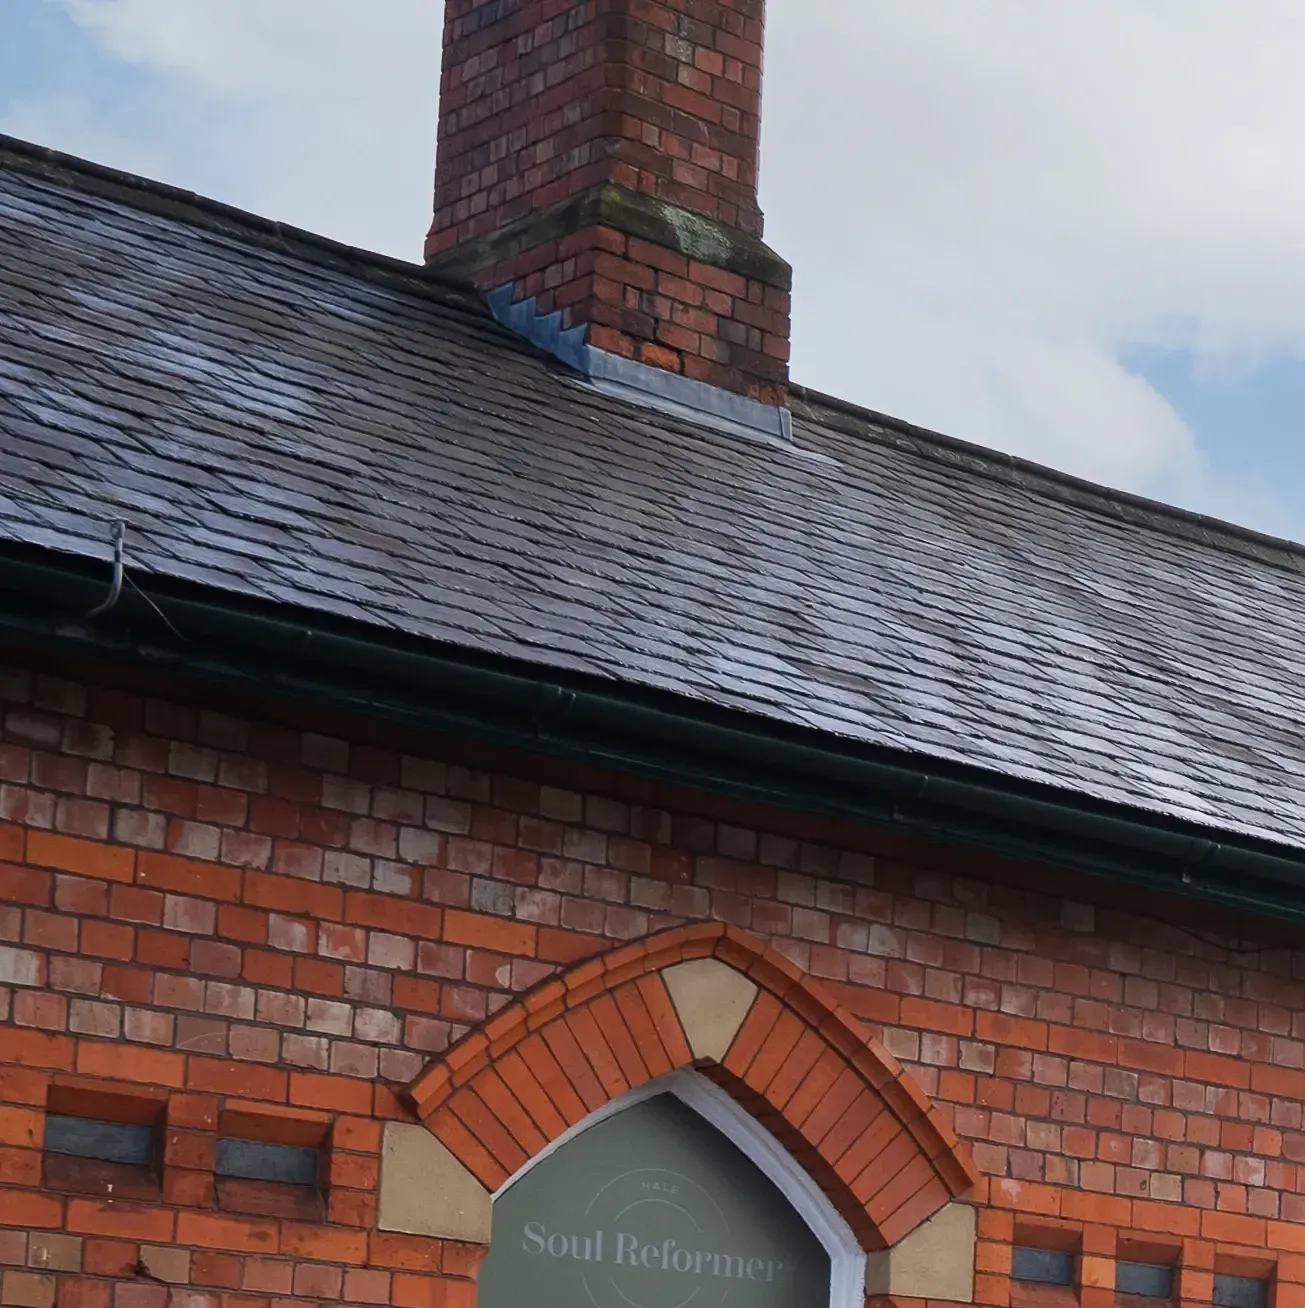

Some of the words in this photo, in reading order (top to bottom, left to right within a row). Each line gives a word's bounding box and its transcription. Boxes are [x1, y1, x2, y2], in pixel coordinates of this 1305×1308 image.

[641, 1181, 680, 1196] HALE
[521, 1221, 604, 1262] Soul
[614, 1231, 785, 1282] Reformer
